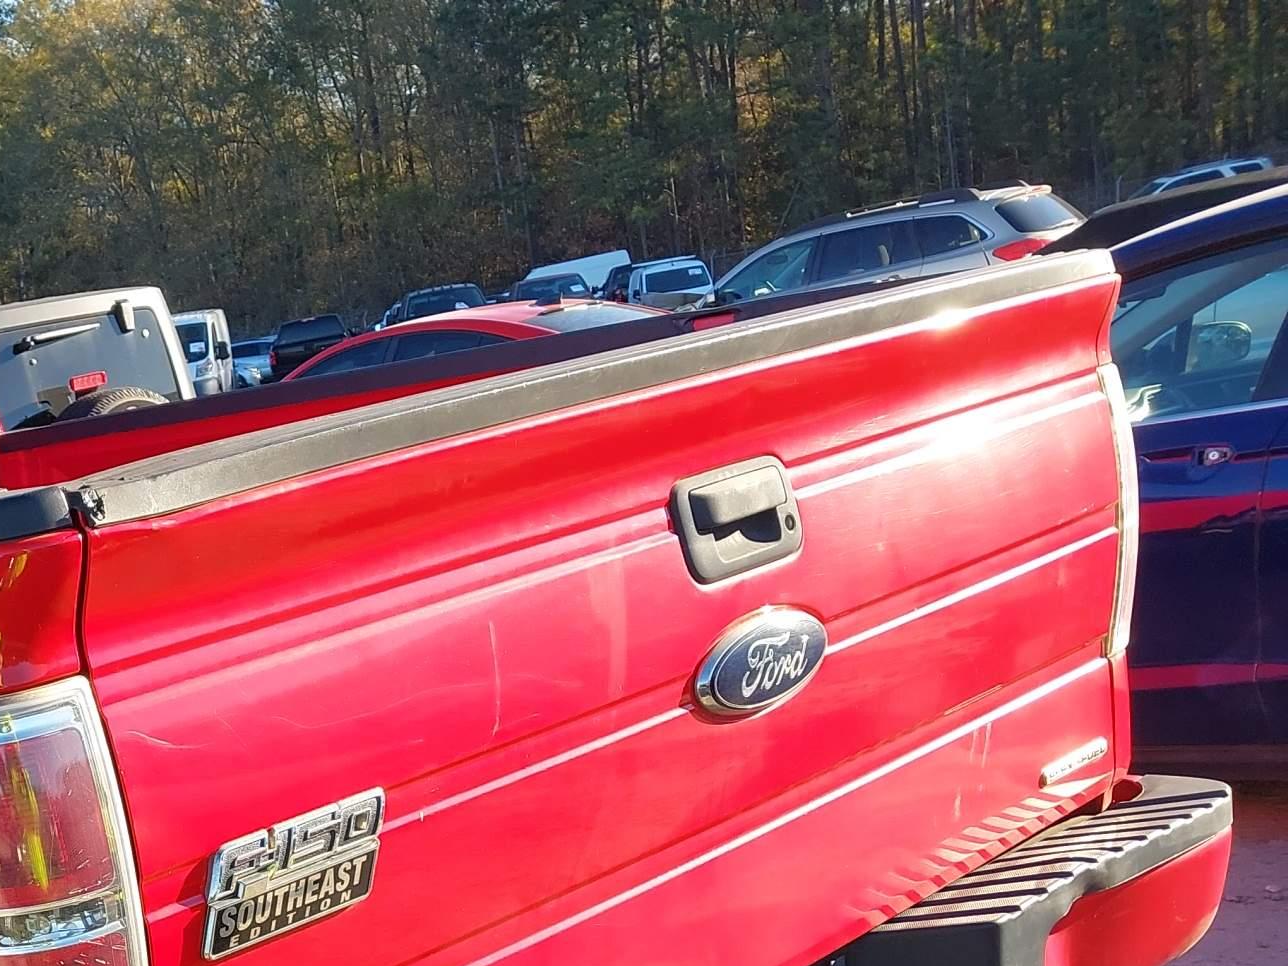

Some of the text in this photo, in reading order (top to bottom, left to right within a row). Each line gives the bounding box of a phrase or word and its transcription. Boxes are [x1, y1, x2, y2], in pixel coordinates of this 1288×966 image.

[741, 631, 810, 698] Ford
[218, 854, 368, 938] SOUTHEAST
[228, 889, 352, 949] EDITION
